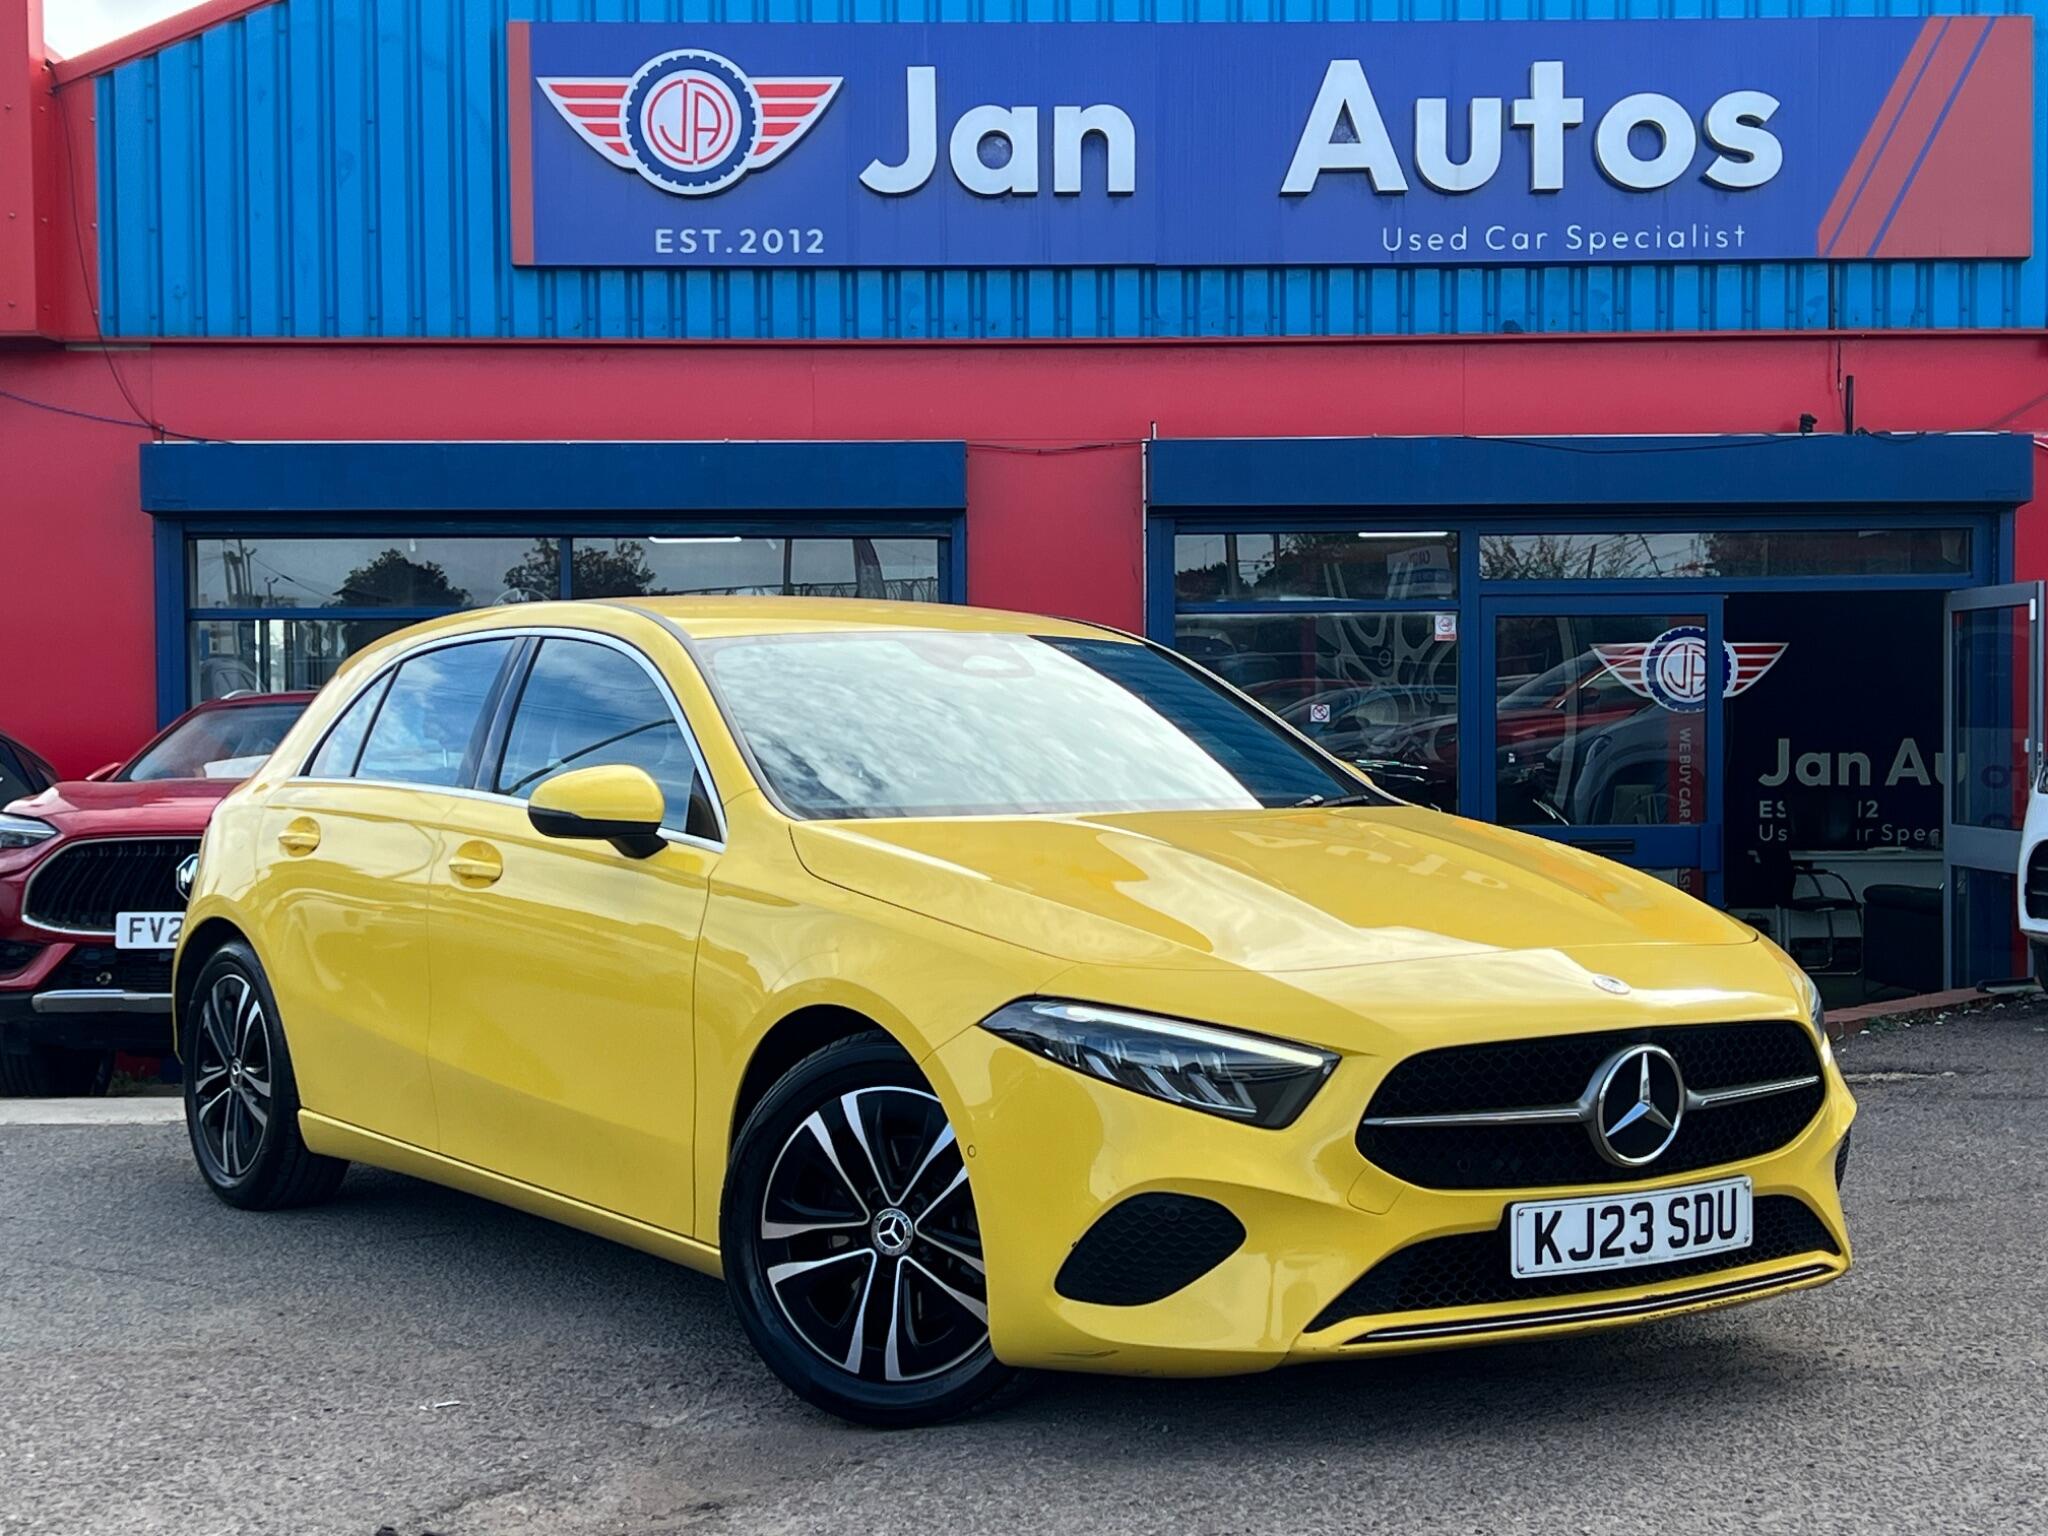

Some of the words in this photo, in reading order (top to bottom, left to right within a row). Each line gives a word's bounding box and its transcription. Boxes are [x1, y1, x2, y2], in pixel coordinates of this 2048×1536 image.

[858, 65, 1136, 195] Jan
[1280, 58, 1784, 196] Autos
[655, 228, 826, 255] EST.2012
[1381, 225, 1469, 252] Used
[1484, 226, 1547, 252] Car
[1566, 224, 1746, 256] Specialist
[1678, 727, 1692, 752] WE
[1678, 754, 1692, 784] BUY
[1758, 737, 1872, 787] Jan
[128, 916, 185, 943] FV2
[1533, 1201, 1655, 1266] KJ23
[1667, 1187, 1738, 1250] SDU
